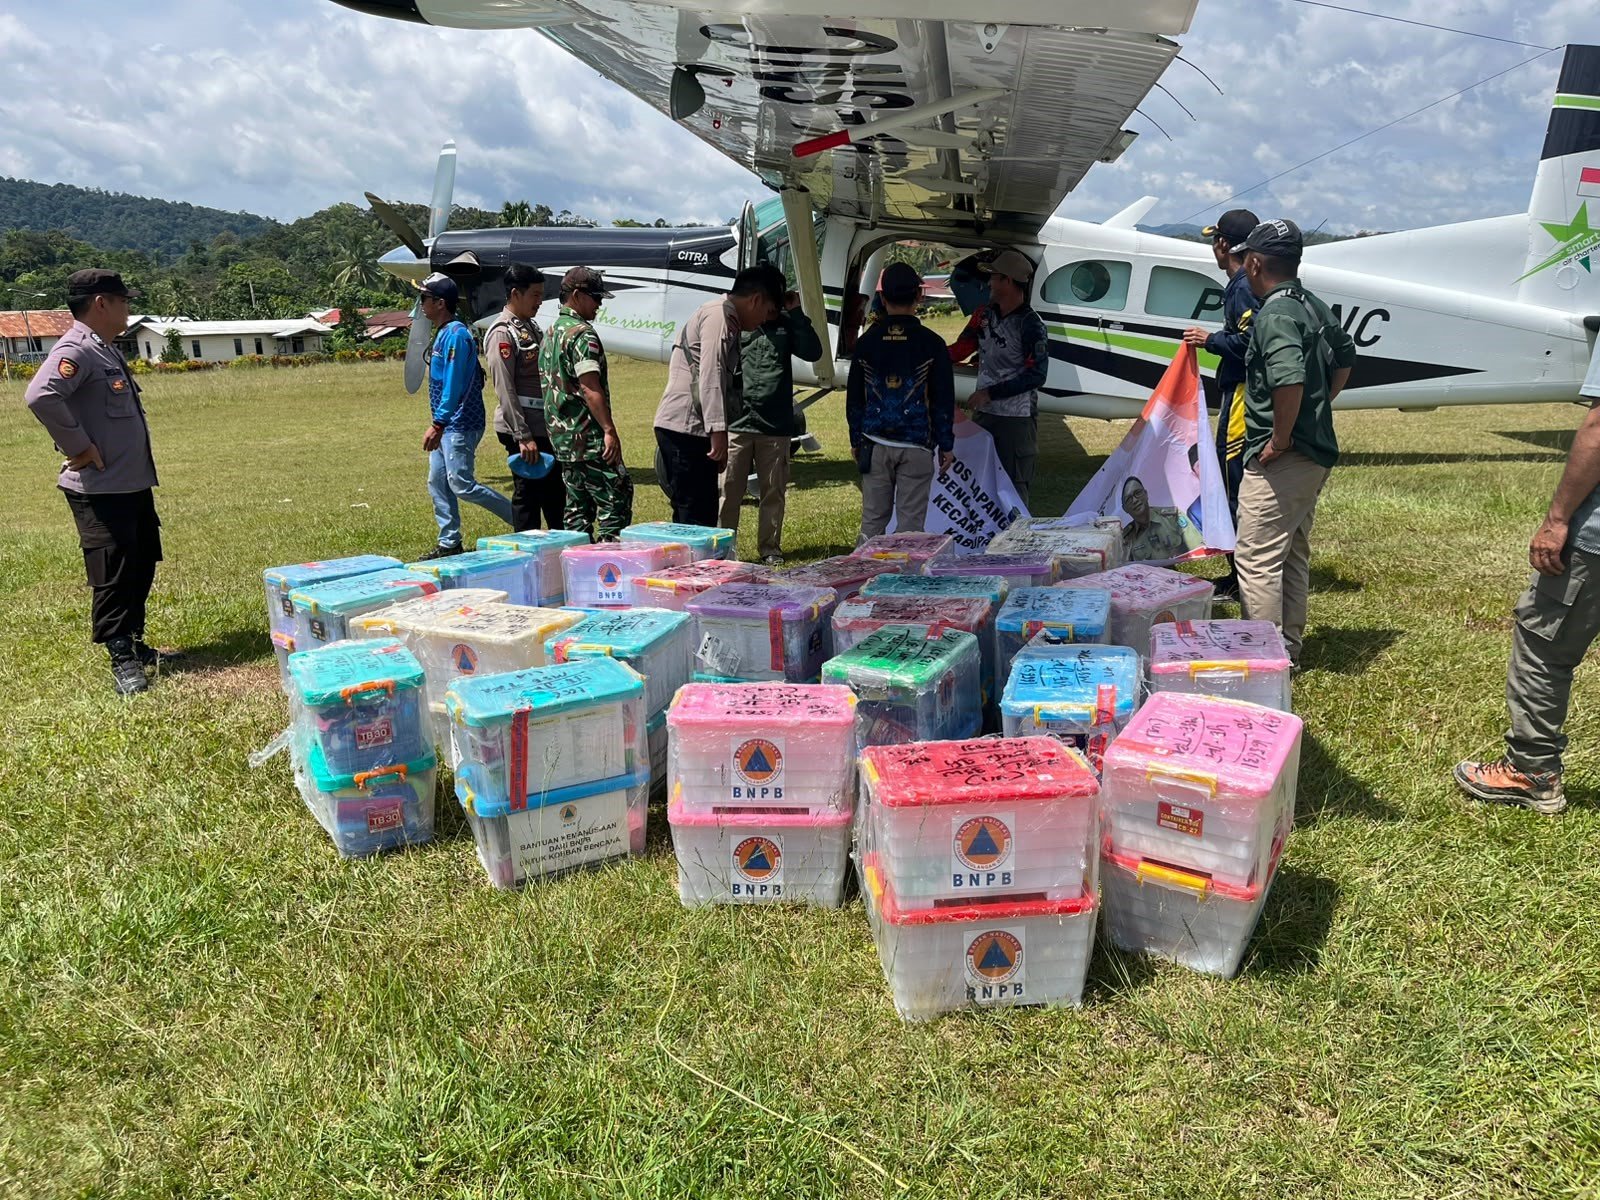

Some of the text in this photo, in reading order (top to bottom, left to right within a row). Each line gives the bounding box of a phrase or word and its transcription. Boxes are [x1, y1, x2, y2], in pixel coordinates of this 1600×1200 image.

[1566, 232, 1600, 254] smart
[677, 250, 709, 263] CITRA
[1562, 257, 1573, 266] air
[620, 318, 677, 339] rising
[951, 456, 973, 482] OS
[598, 591, 623, 599] BNPB
[733, 786, 783, 799] BNPB
[520, 836, 559, 851] BANTUAN
[548, 847, 582, 860] KORBAN
[953, 872, 1012, 887] BNPB
[732, 883, 782, 896] BNPB
[968, 931, 1020, 953] BADAN NASIONAL
[965, 982, 1024, 1000] BNPB
